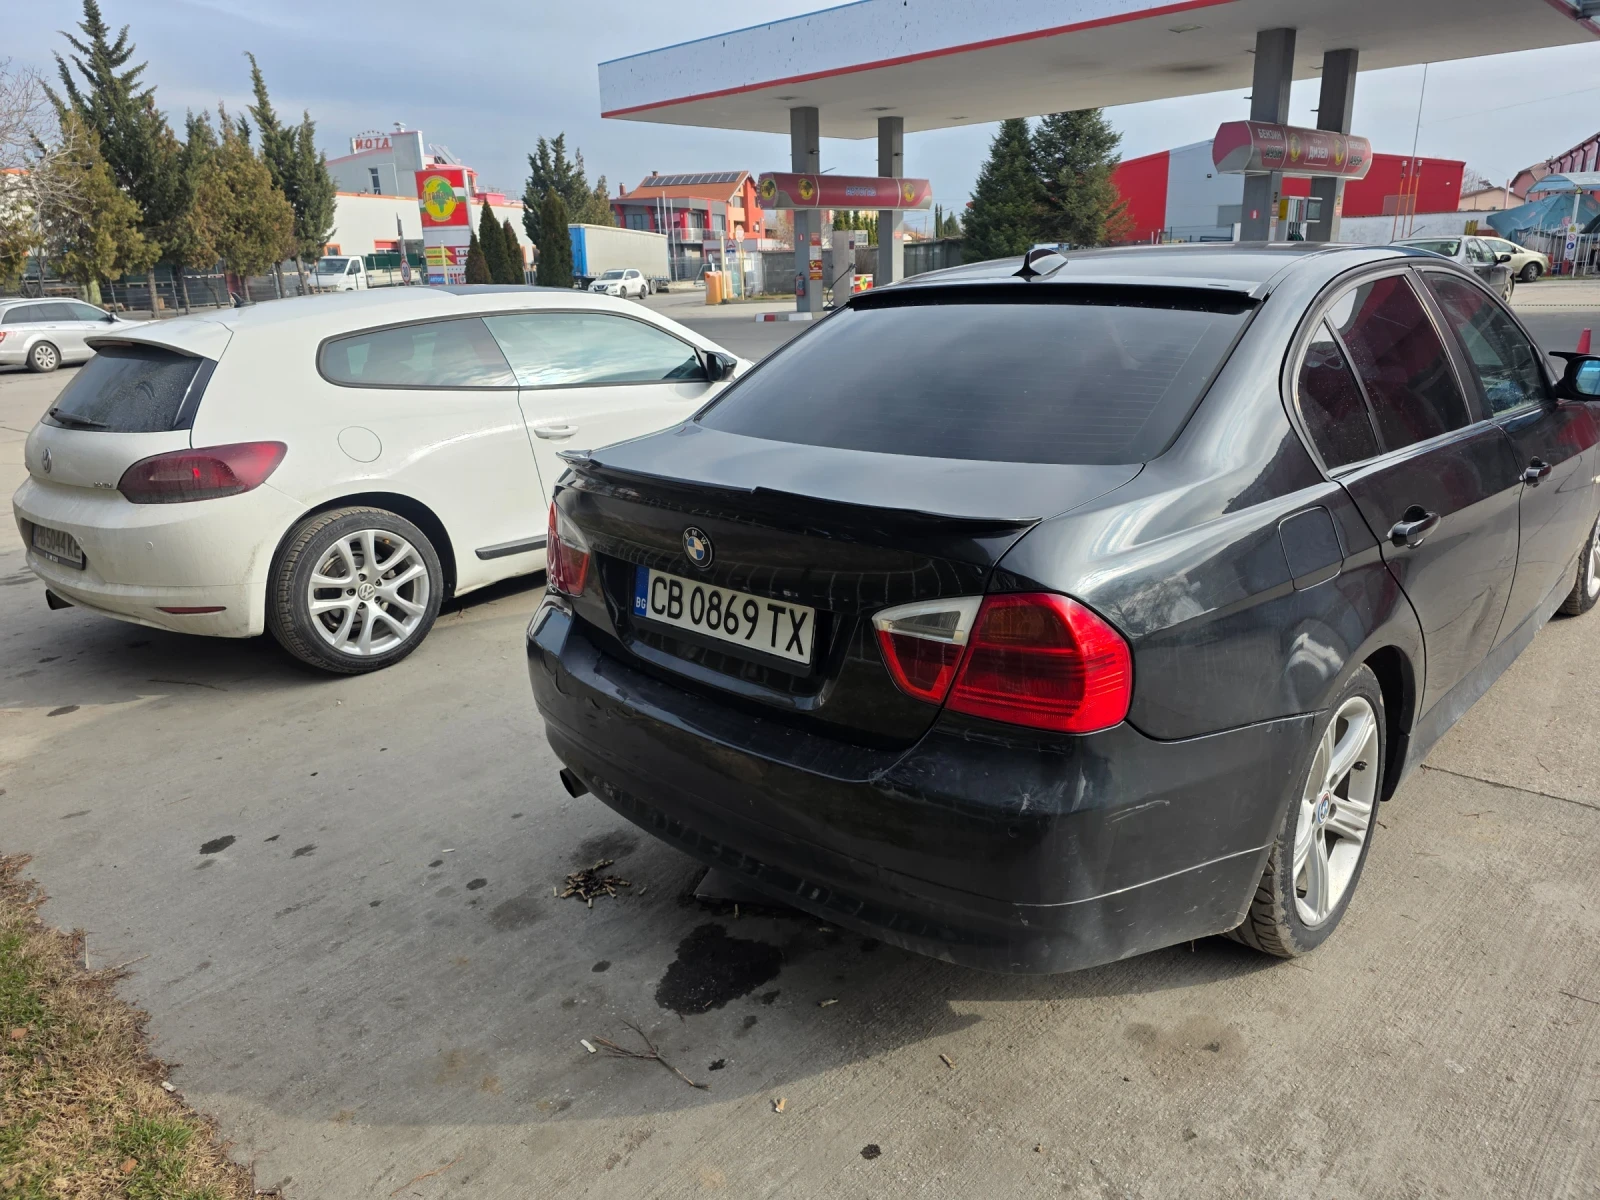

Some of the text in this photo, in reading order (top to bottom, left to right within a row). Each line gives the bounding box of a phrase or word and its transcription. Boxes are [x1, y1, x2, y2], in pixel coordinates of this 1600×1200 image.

[1308, 146, 1328, 160] ДИЗЕЛ
[684, 529, 708, 545] BMW
[635, 576, 808, 656] BG CB 0869 TX
